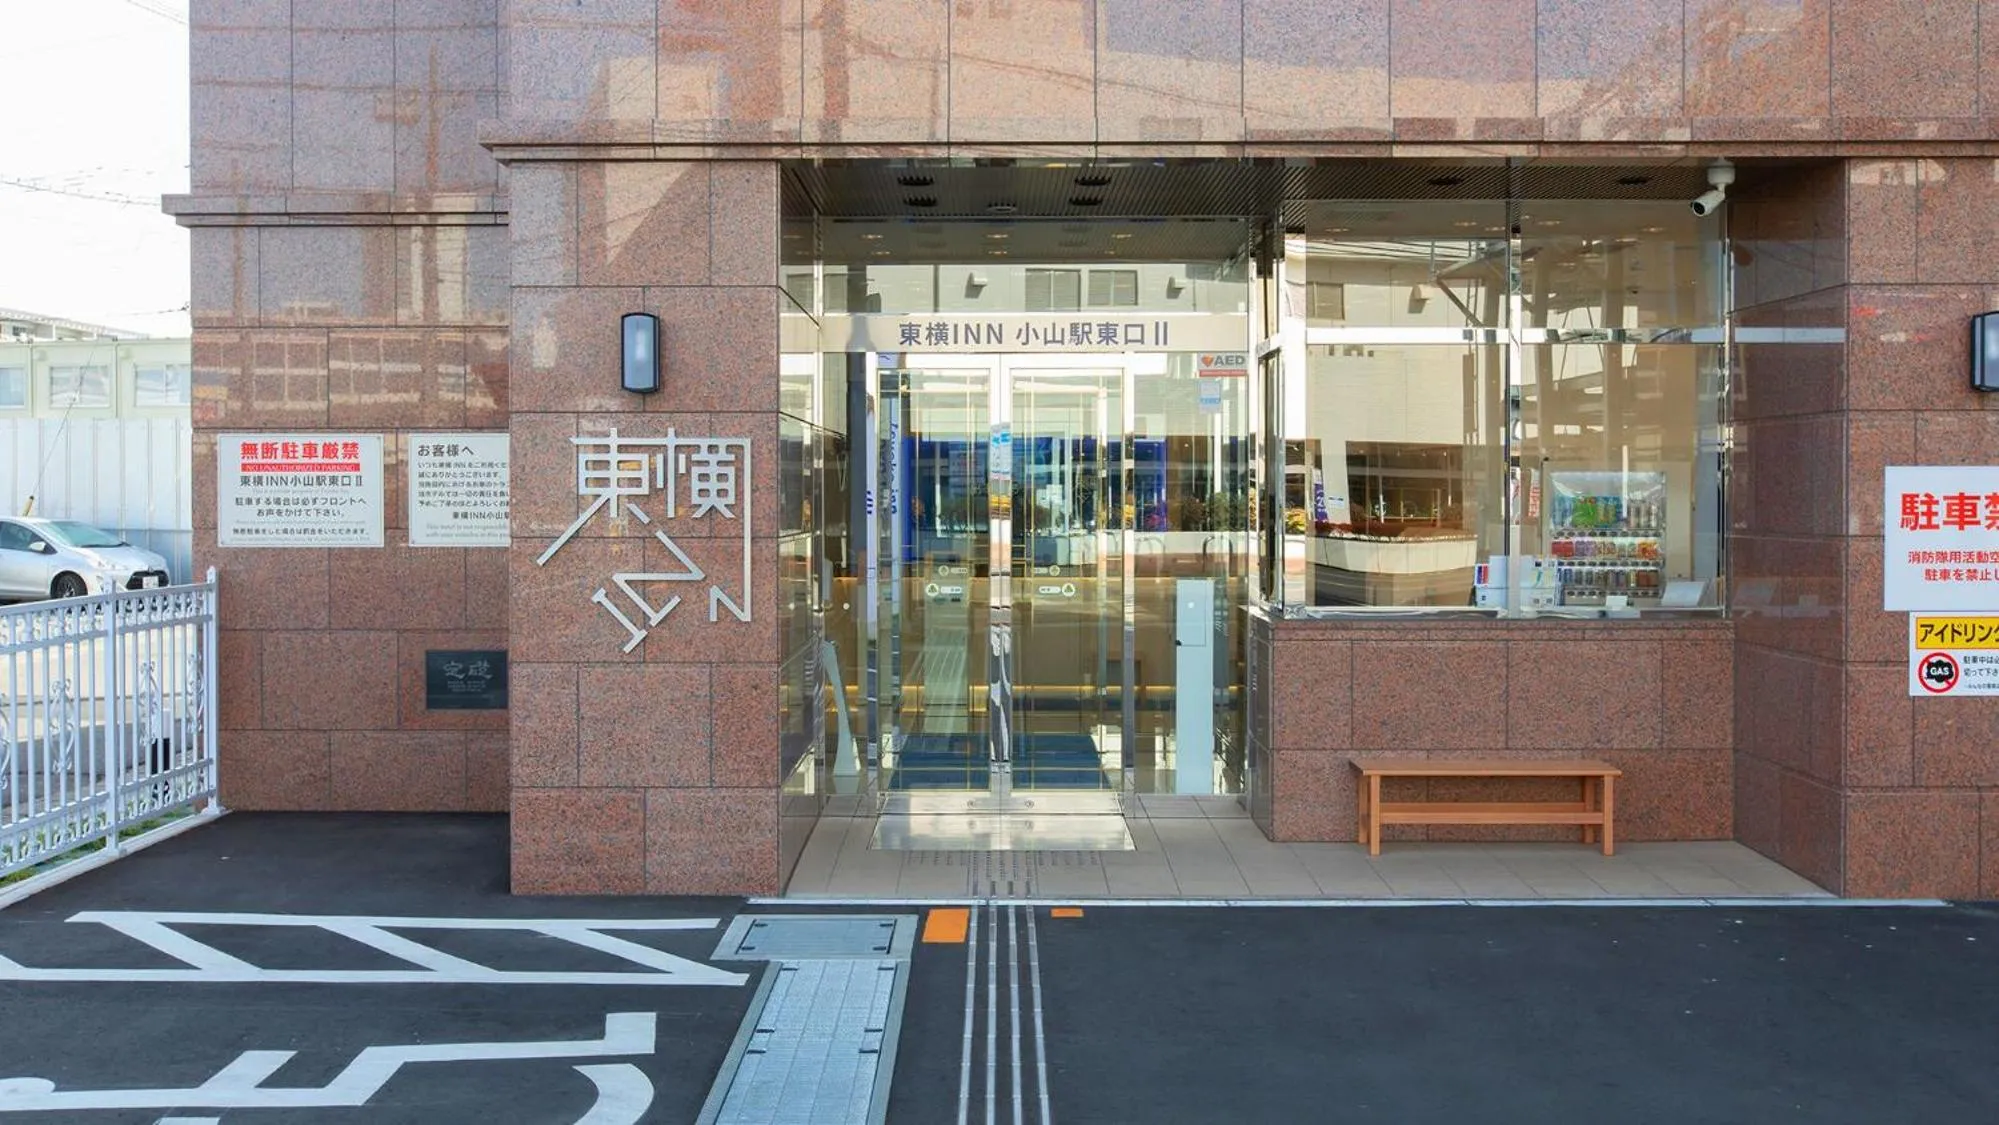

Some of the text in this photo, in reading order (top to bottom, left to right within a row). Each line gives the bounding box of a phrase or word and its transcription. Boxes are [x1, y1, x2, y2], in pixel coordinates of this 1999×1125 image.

[899, 322, 1004, 346] 東横INN
[1214, 355, 1245, 366] AED
[240, 442, 359, 460] 無断駐車厳禁
[418, 444, 474, 457] お客様へ
[235, 496, 367, 506] 駐車する場合は必ずフロントへ
[256, 508, 345, 518] お声をかけて下さい。
[1930, 667, 1949, 676] GAS
